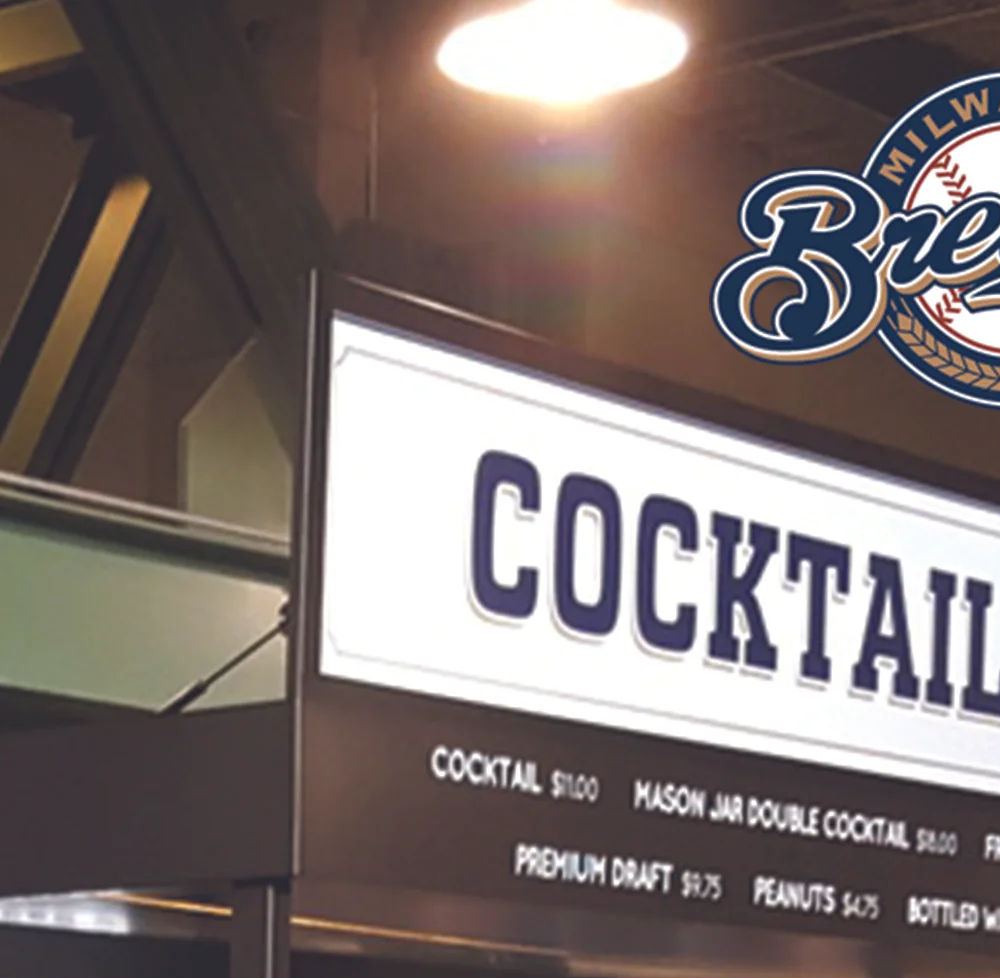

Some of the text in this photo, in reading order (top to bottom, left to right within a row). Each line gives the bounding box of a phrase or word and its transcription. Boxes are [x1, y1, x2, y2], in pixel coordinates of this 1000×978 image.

[431, 745, 543, 795] COCKTAIL
[551, 769, 599, 803] $11.00
[633, 778, 706, 819] MASON
[709, 791, 744, 824] JAR
[747, 795, 819, 837] DOUBLE
[823, 809, 910, 850] COCKTAIL
[514, 841, 606, 886] PREMIUM
[610, 856, 675, 893] DRAFT
[753, 875, 836, 915] PEANUTS
[907, 895, 979, 931] BOTTLED
